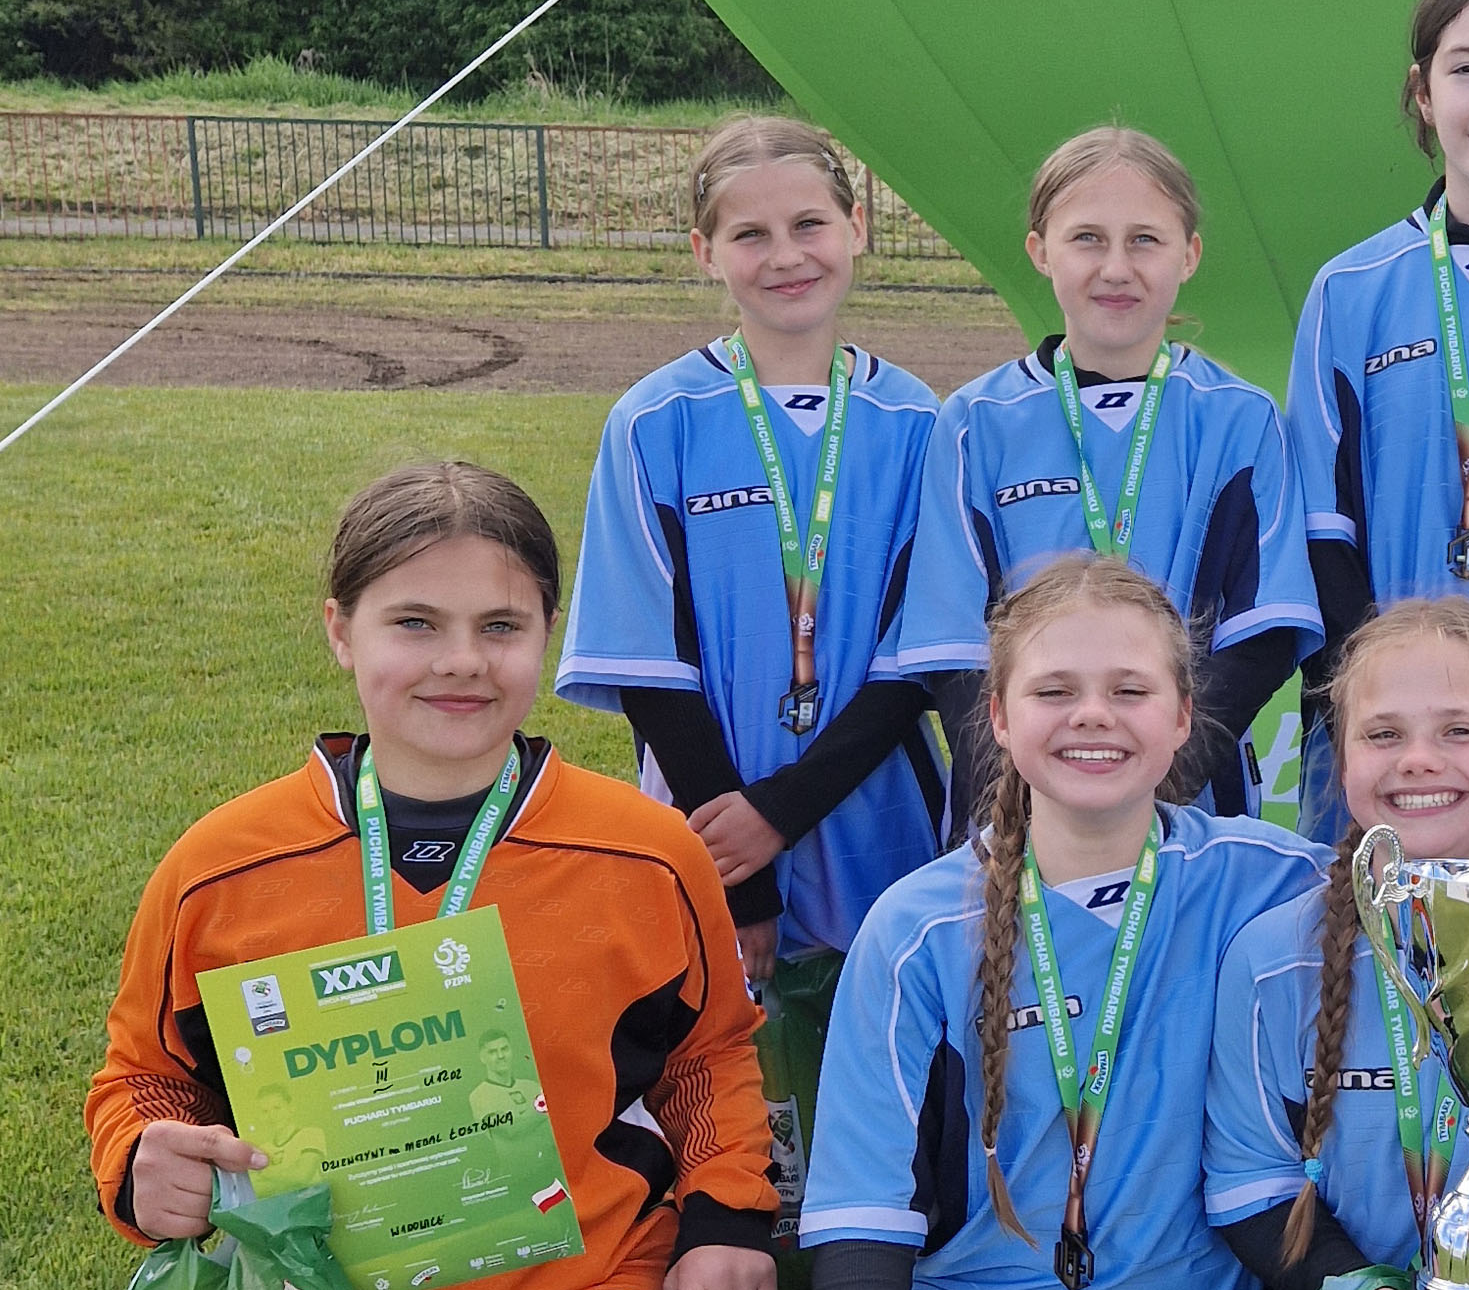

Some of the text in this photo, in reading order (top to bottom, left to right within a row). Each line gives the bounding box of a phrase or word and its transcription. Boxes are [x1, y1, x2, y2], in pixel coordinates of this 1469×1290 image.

[1438, 266, 1454, 312] PUCHAR
[1366, 340, 1436, 374] zina
[1445, 315, 1464, 380] TYMBARKU
[831, 374, 846, 431] TYMBARKU
[823, 435, 840, 482] PUCHAR
[1125, 385, 1158, 497] PUCHAR TYMBARKU
[687, 487, 775, 514] zina
[753, 414, 793, 533] PUCHAR TYMBARKU
[996, 478, 1079, 505] zina
[366, 816, 385, 879] PUCHAR
[458, 804, 500, 880] TYMBARKU
[318, 955, 392, 995] XXV
[444, 974, 472, 990] PZPN
[1029, 912, 1068, 1057] PUCHAR TYMBARKU
[1101, 891, 1146, 1035] PUCHAR TYMBARKU
[283, 1010, 467, 1079] DYPLOM
[1390, 1013, 1413, 1097] TYMBARKU
